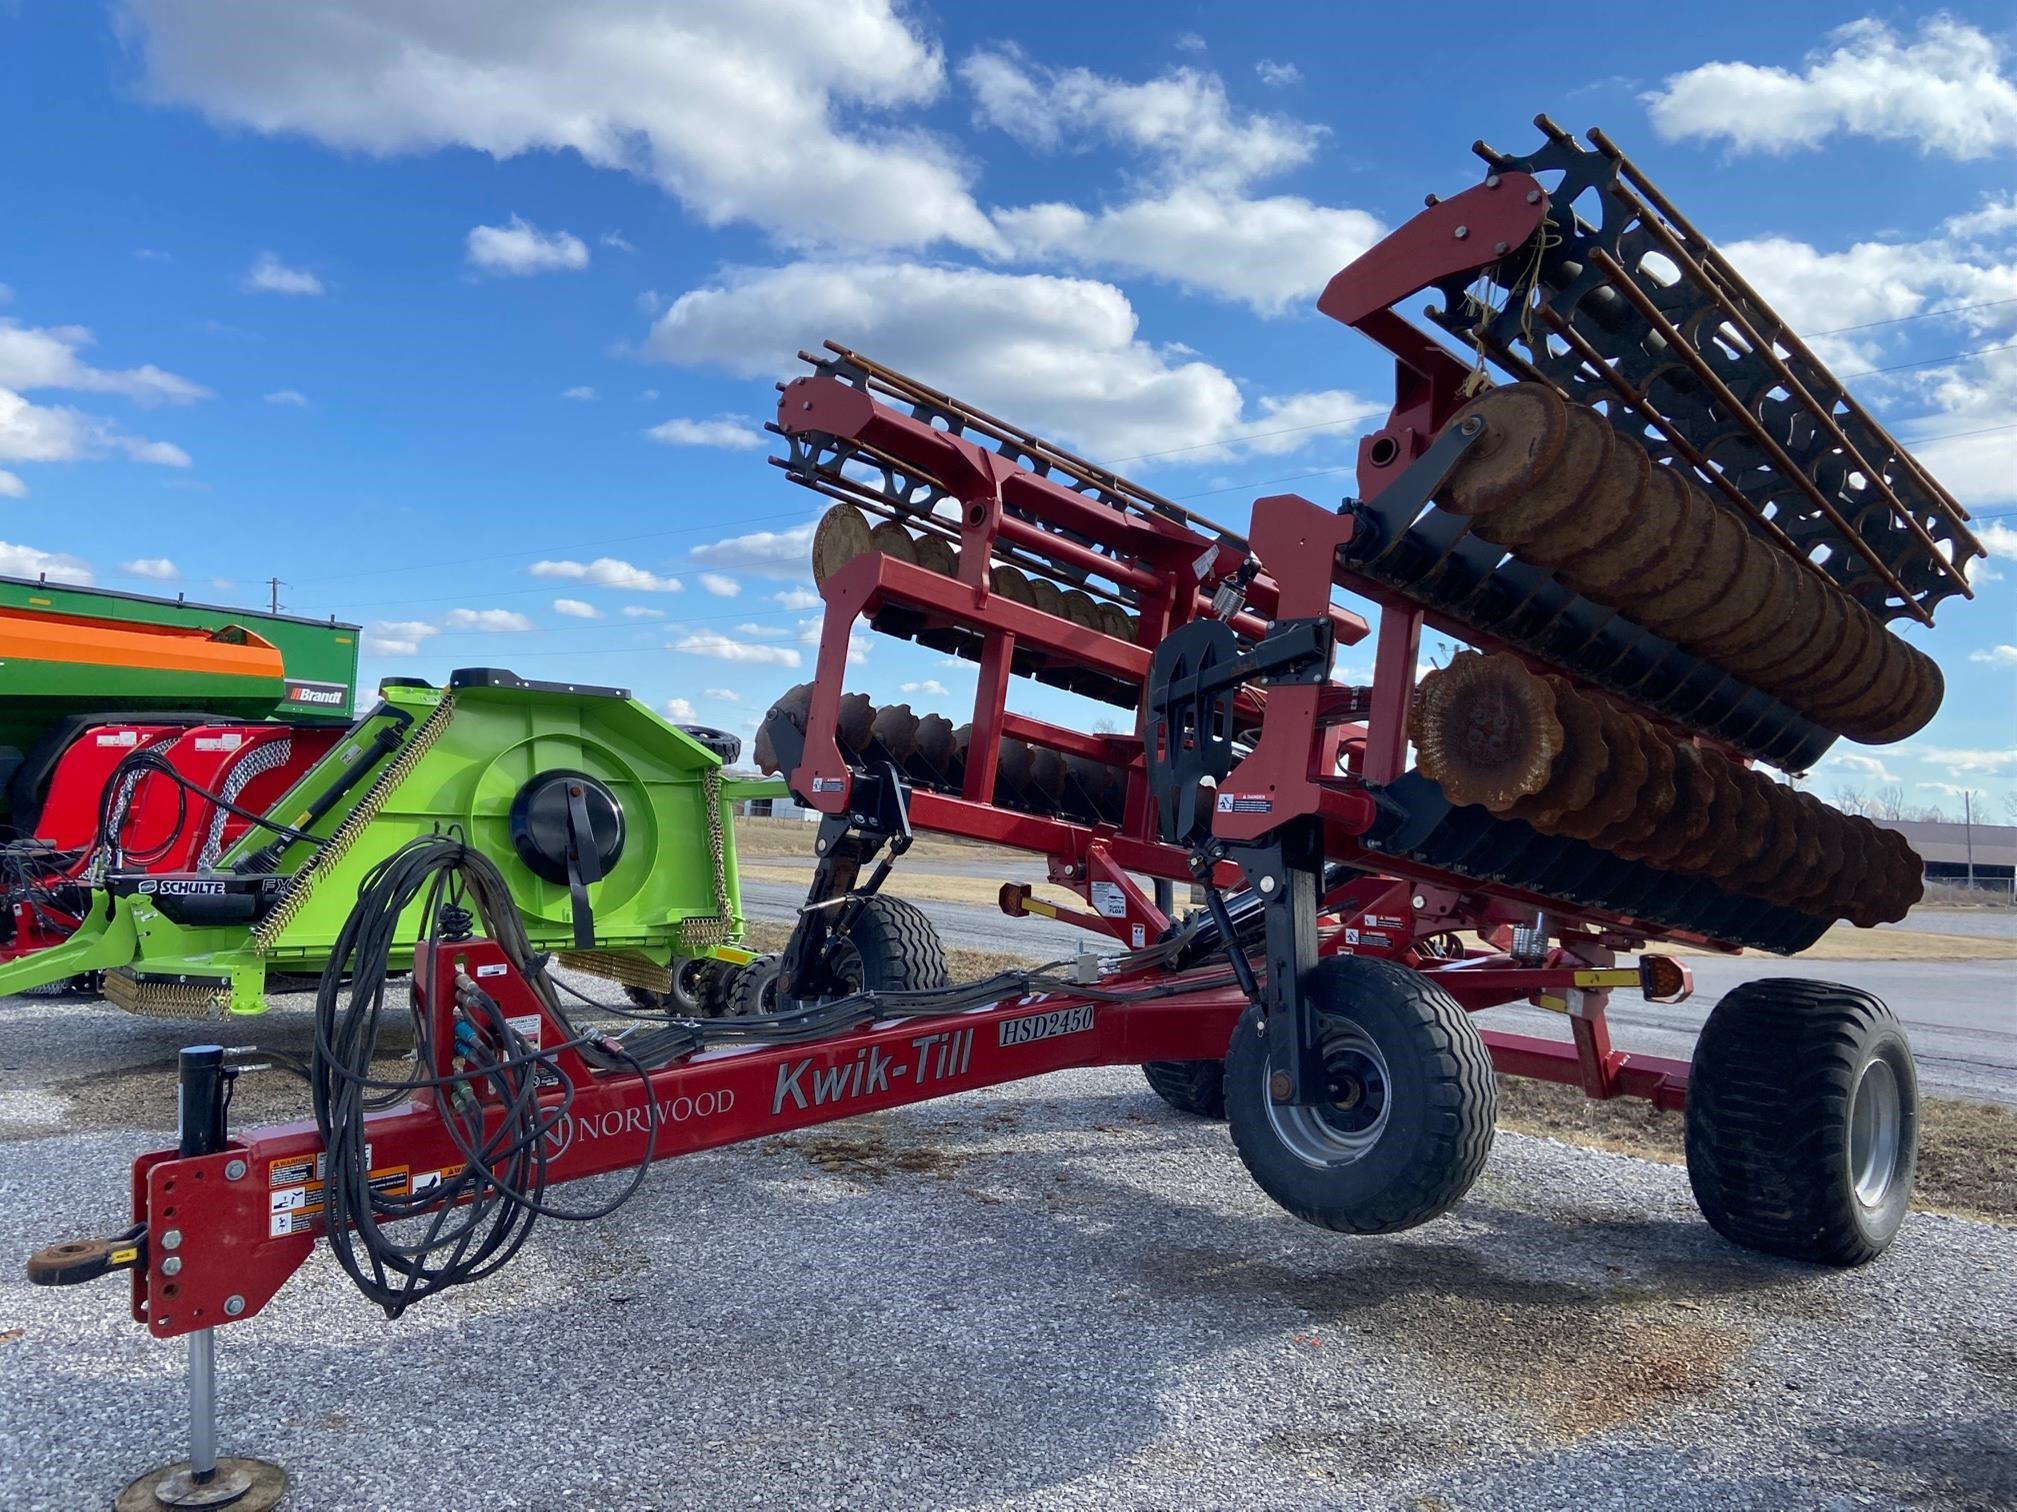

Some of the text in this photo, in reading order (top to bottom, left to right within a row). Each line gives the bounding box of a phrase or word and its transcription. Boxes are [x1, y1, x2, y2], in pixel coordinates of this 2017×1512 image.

[300, 688, 342, 704] Brandt
[160, 880, 225, 895] SCHULTE
[1001, 1007, 1093, 1045] HSD2450
[771, 1028, 975, 1115] Kwik-Till
[578, 1089, 735, 1142] NORWOOD
